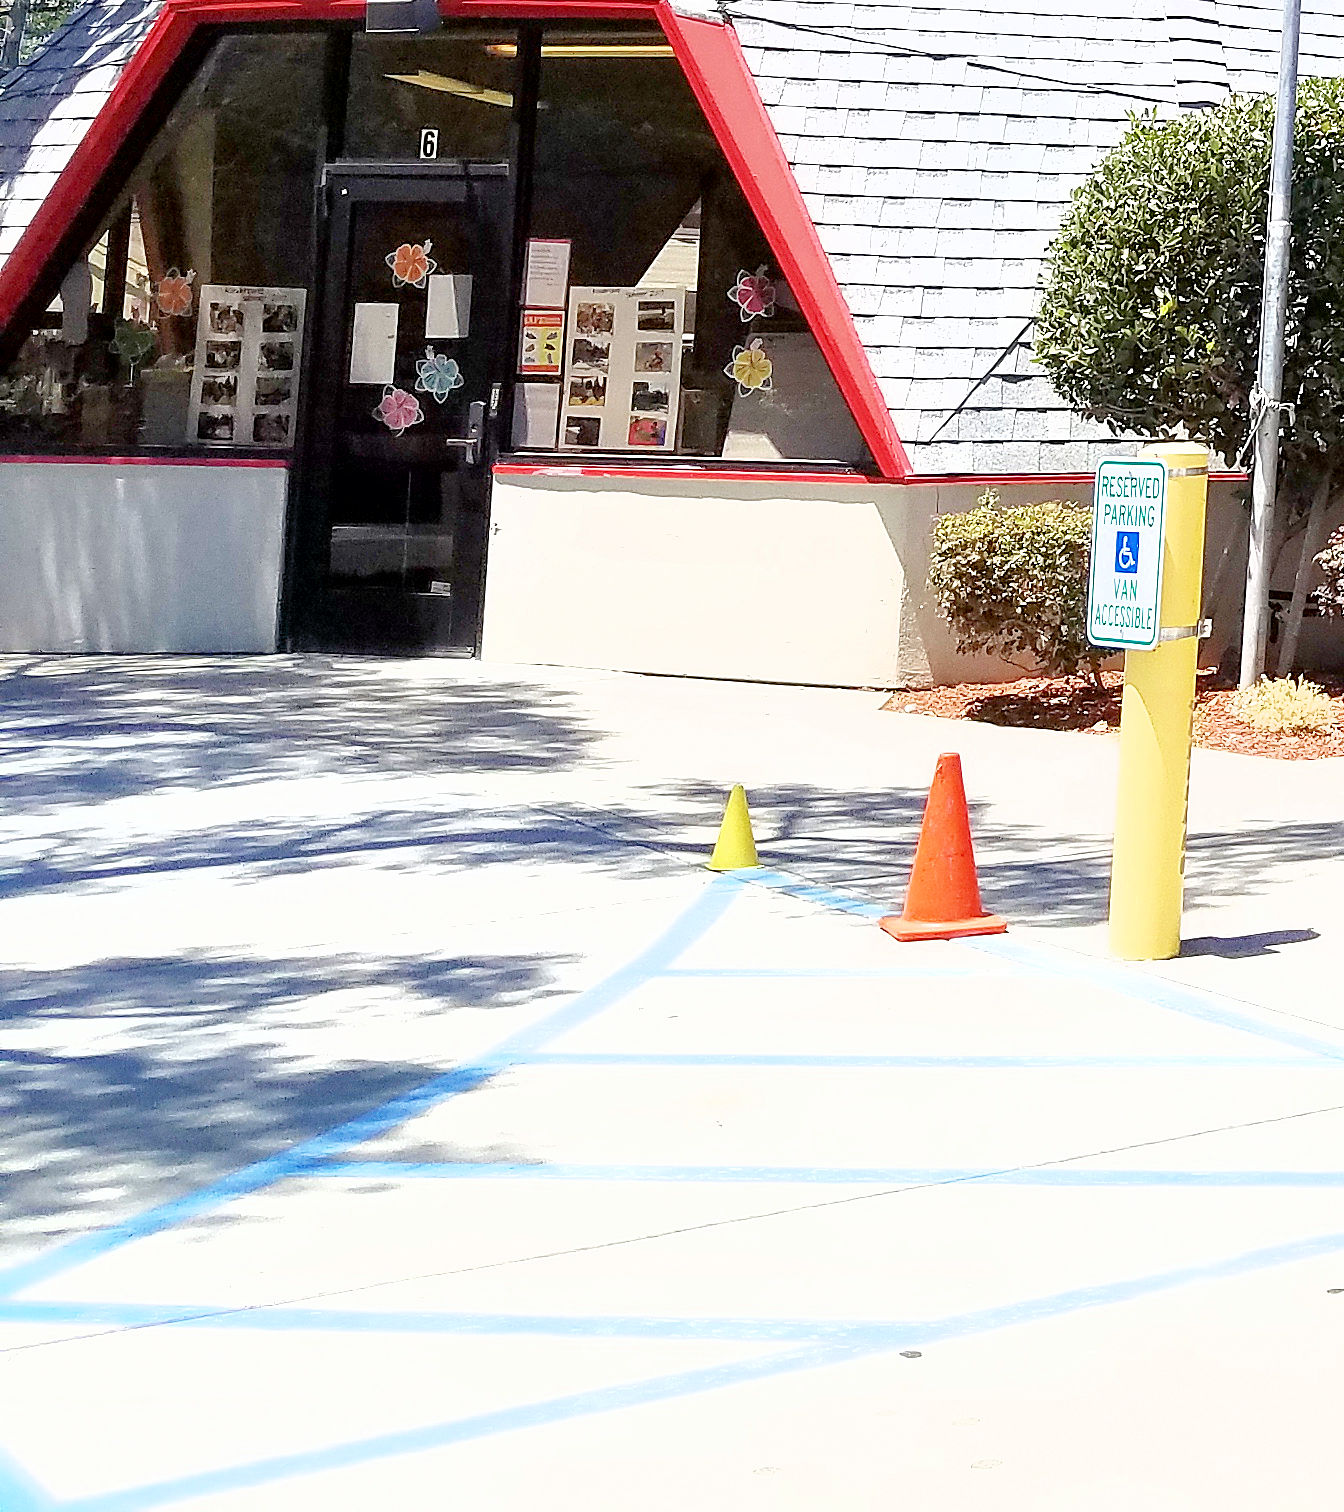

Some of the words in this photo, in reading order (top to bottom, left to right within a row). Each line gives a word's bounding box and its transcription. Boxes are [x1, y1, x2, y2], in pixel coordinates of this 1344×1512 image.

[423, 131, 435, 157] 6
[1101, 475, 1160, 499] RESERVED
[1103, 503, 1155, 527] PARKING
[1113, 578, 1137, 601] VAN
[1094, 603, 1153, 629] ACCESSIBLE
